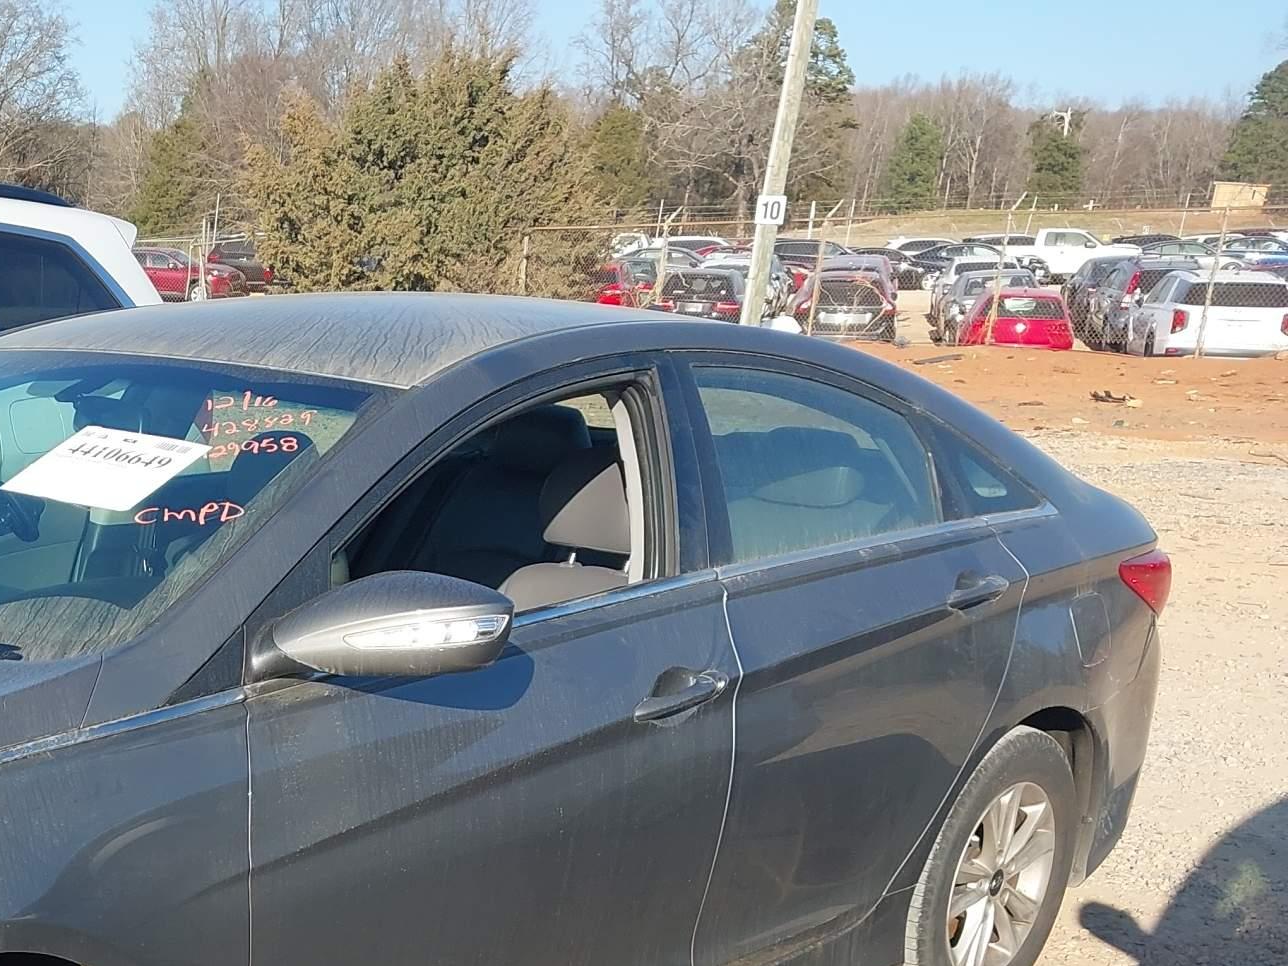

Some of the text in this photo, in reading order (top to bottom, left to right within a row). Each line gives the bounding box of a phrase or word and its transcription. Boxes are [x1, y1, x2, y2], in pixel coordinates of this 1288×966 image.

[762, 201, 781, 220] 10
[206, 390, 278, 411] 12/16
[202, 410, 318, 436] 428829
[68, 442, 173, 470] 44106649
